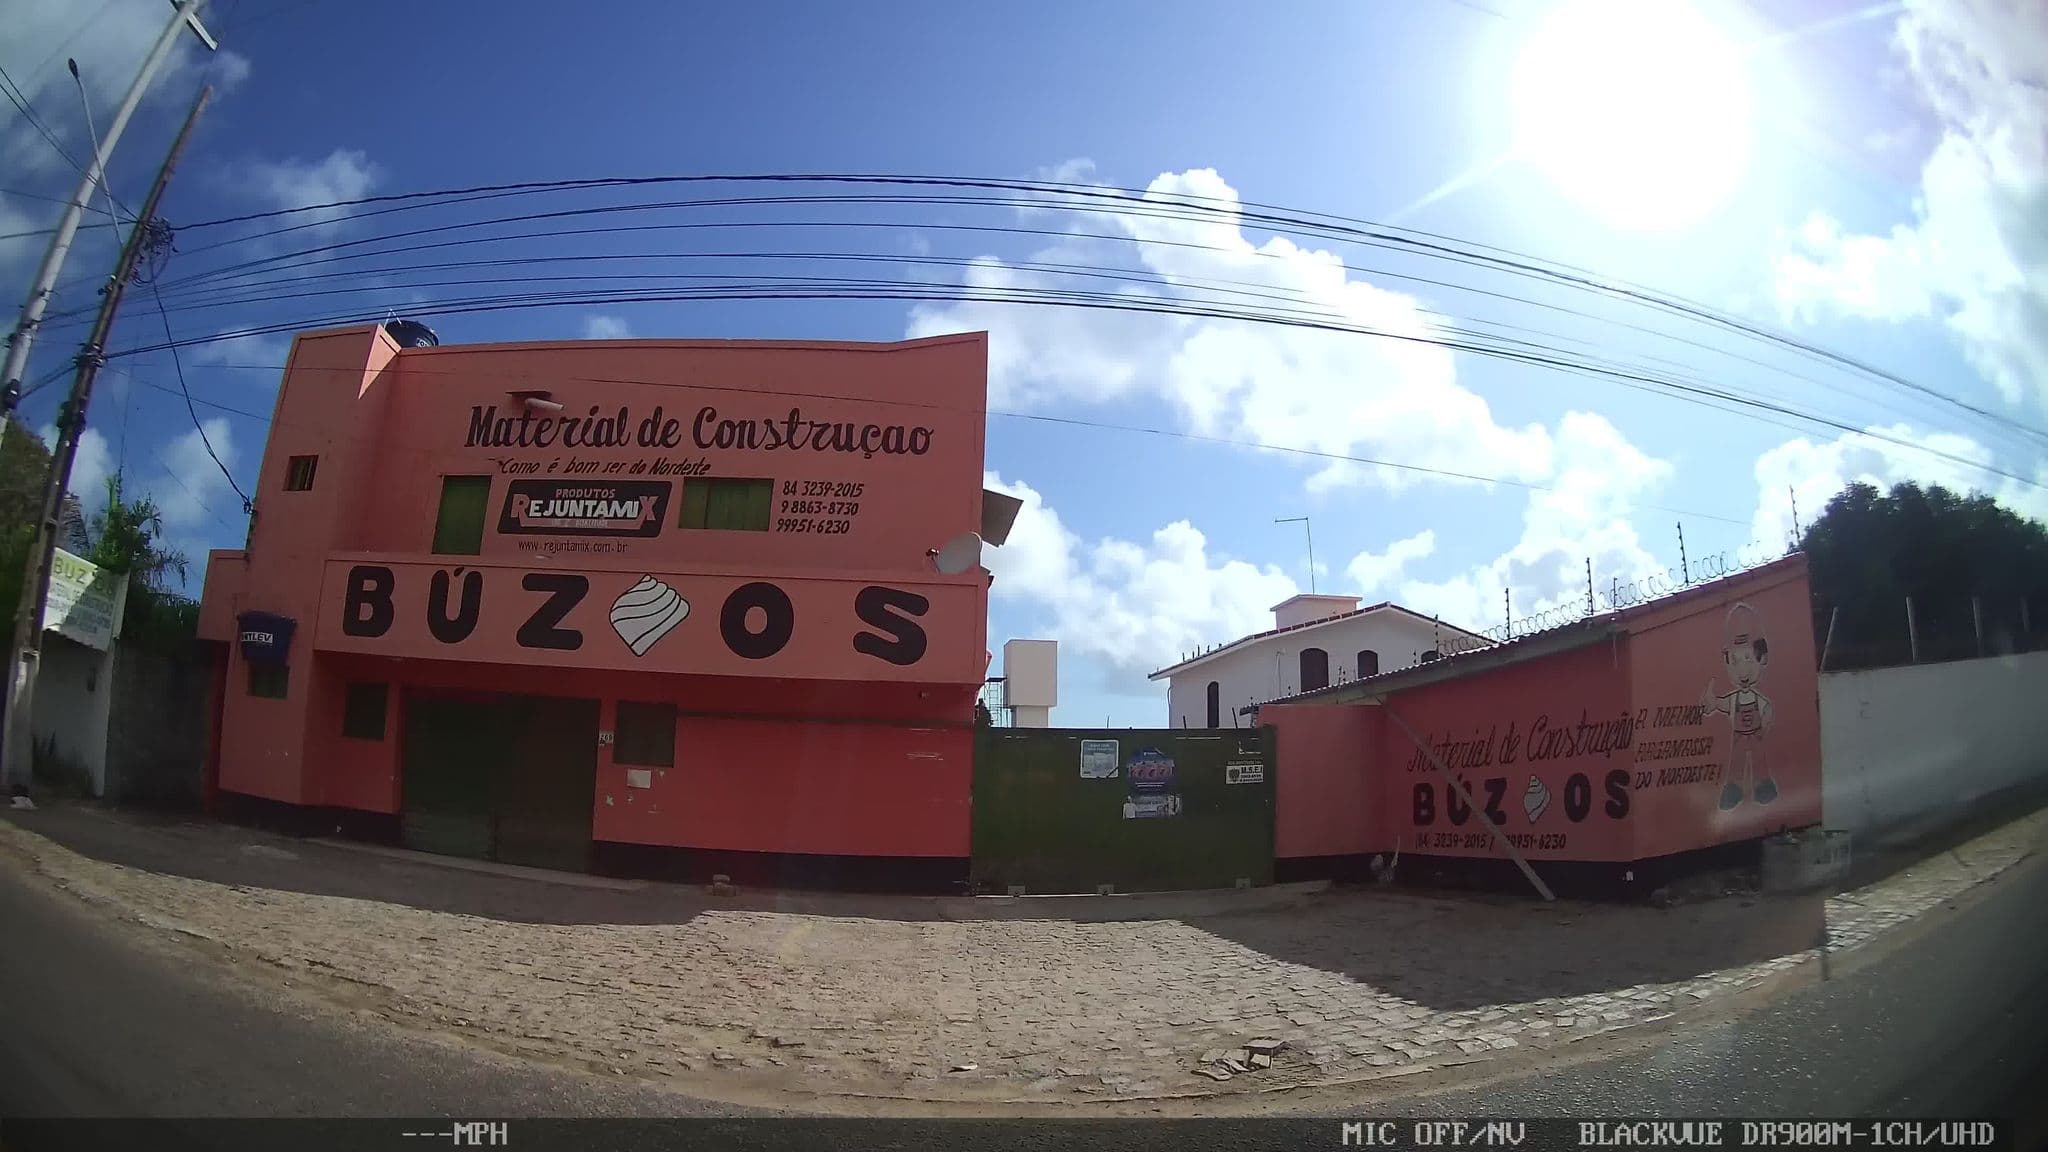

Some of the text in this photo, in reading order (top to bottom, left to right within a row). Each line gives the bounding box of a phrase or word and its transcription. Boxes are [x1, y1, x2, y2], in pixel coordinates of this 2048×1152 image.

[464, 405, 630, 448] Material
[637, 406, 682, 448] de
[563, 456, 600, 474] bom
[602, 461, 628, 474] ser
[649, 457, 711, 475] Nordeste
[555, 488, 616, 499] PRODUTOS
[782, 480, 864, 498] 84 3239-2015
[510, 493, 659, 521] REJUNTAMIX
[781, 501, 859, 516] 9 8863-8730
[776, 518, 850, 534] 99951-6230
[1499, 721, 1521, 764] de
[1527, 708, 1635, 762] Construção
[1635, 771, 1653, 789] DO
